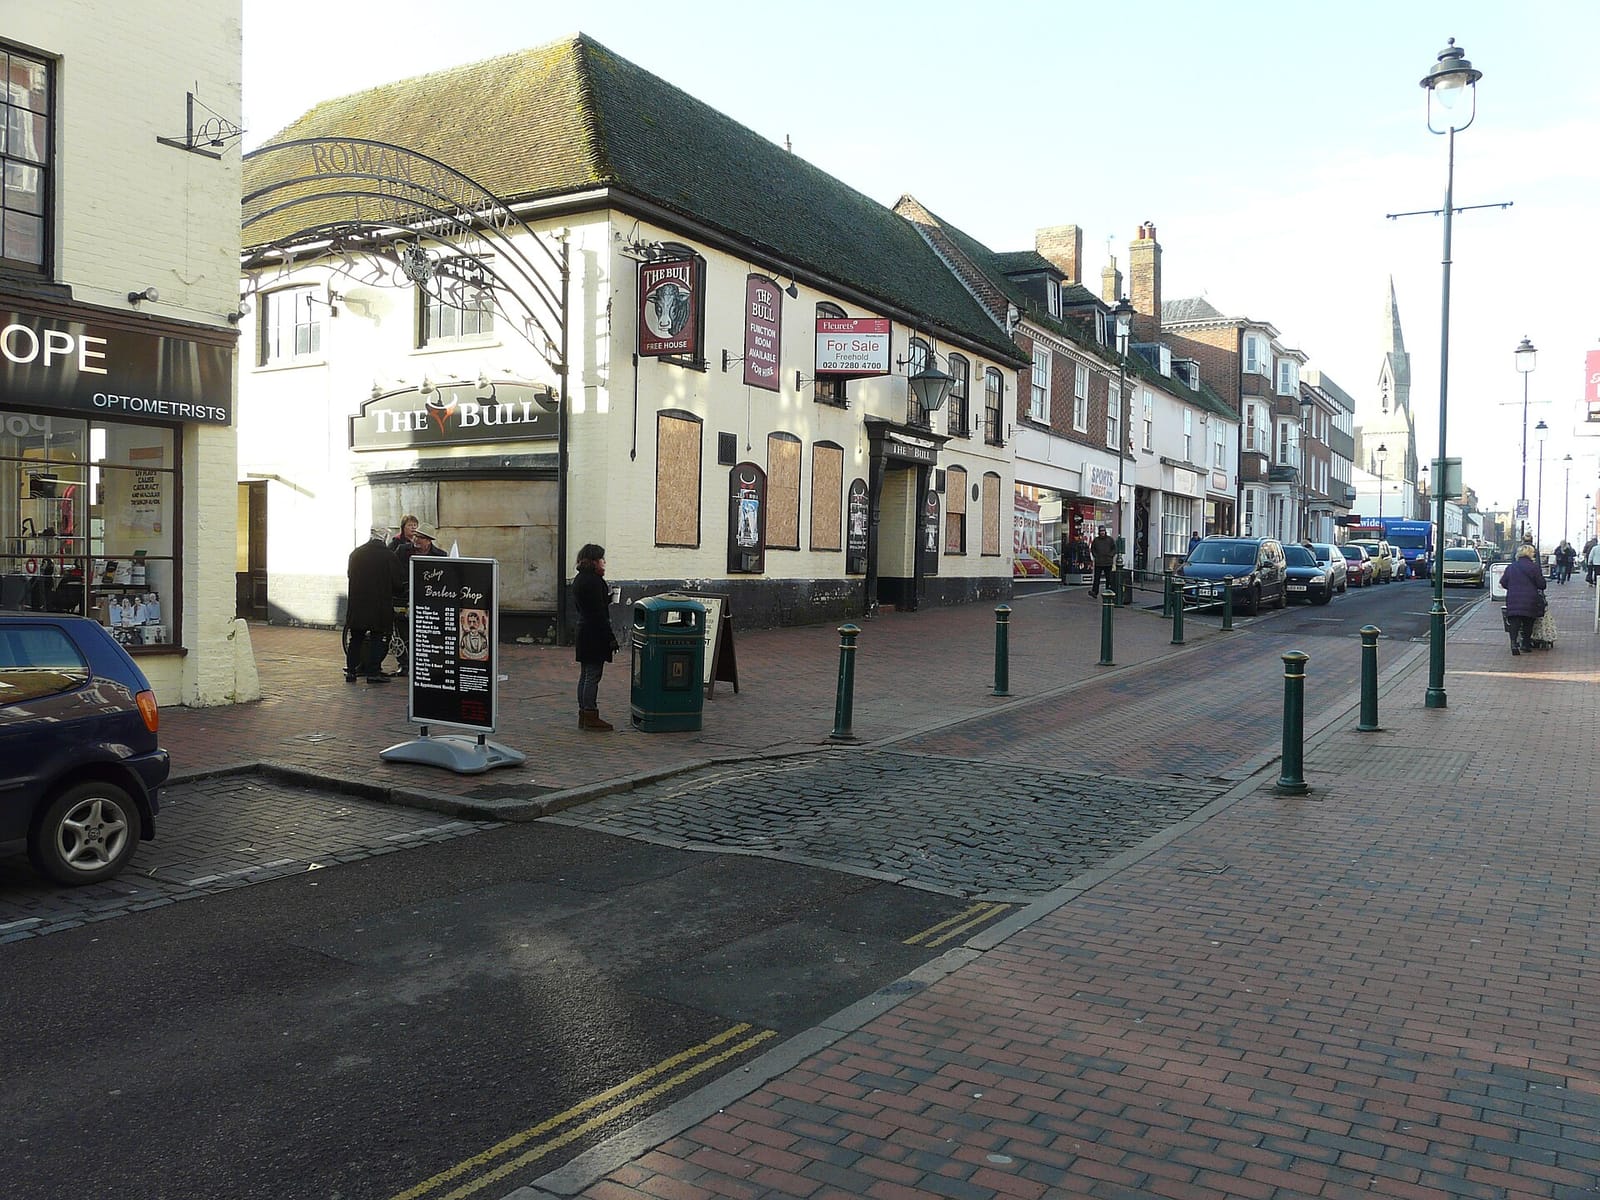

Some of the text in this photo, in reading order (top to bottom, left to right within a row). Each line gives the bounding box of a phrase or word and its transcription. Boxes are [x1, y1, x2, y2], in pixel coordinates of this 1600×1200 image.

[311, 144, 410, 180] ROMAN
[644, 266, 692, 292] THE BULL
[756, 289, 772, 305] THE
[752, 303, 775, 321] BULL
[751, 323, 776, 338] FUNCTION
[823, 321, 854, 330] Fleurets
[0, 324, 108, 374] OPE
[664, 341, 687, 349] HOUSE
[755, 336, 771, 349] ROOM
[827, 340, 879, 351] For Sale
[749, 348, 776, 363] AVAILABLE
[835, 353, 869, 361] Freehold
[751, 361, 774, 377] FOR HIRE
[93, 393, 226, 420] OPTOMETRISTS
[371, 401, 539, 433] THE BULL
[892, 443, 931, 460] THE BULL
[1091, 466, 1113, 487] SPORTS
[460, 586, 483, 604] Shop
